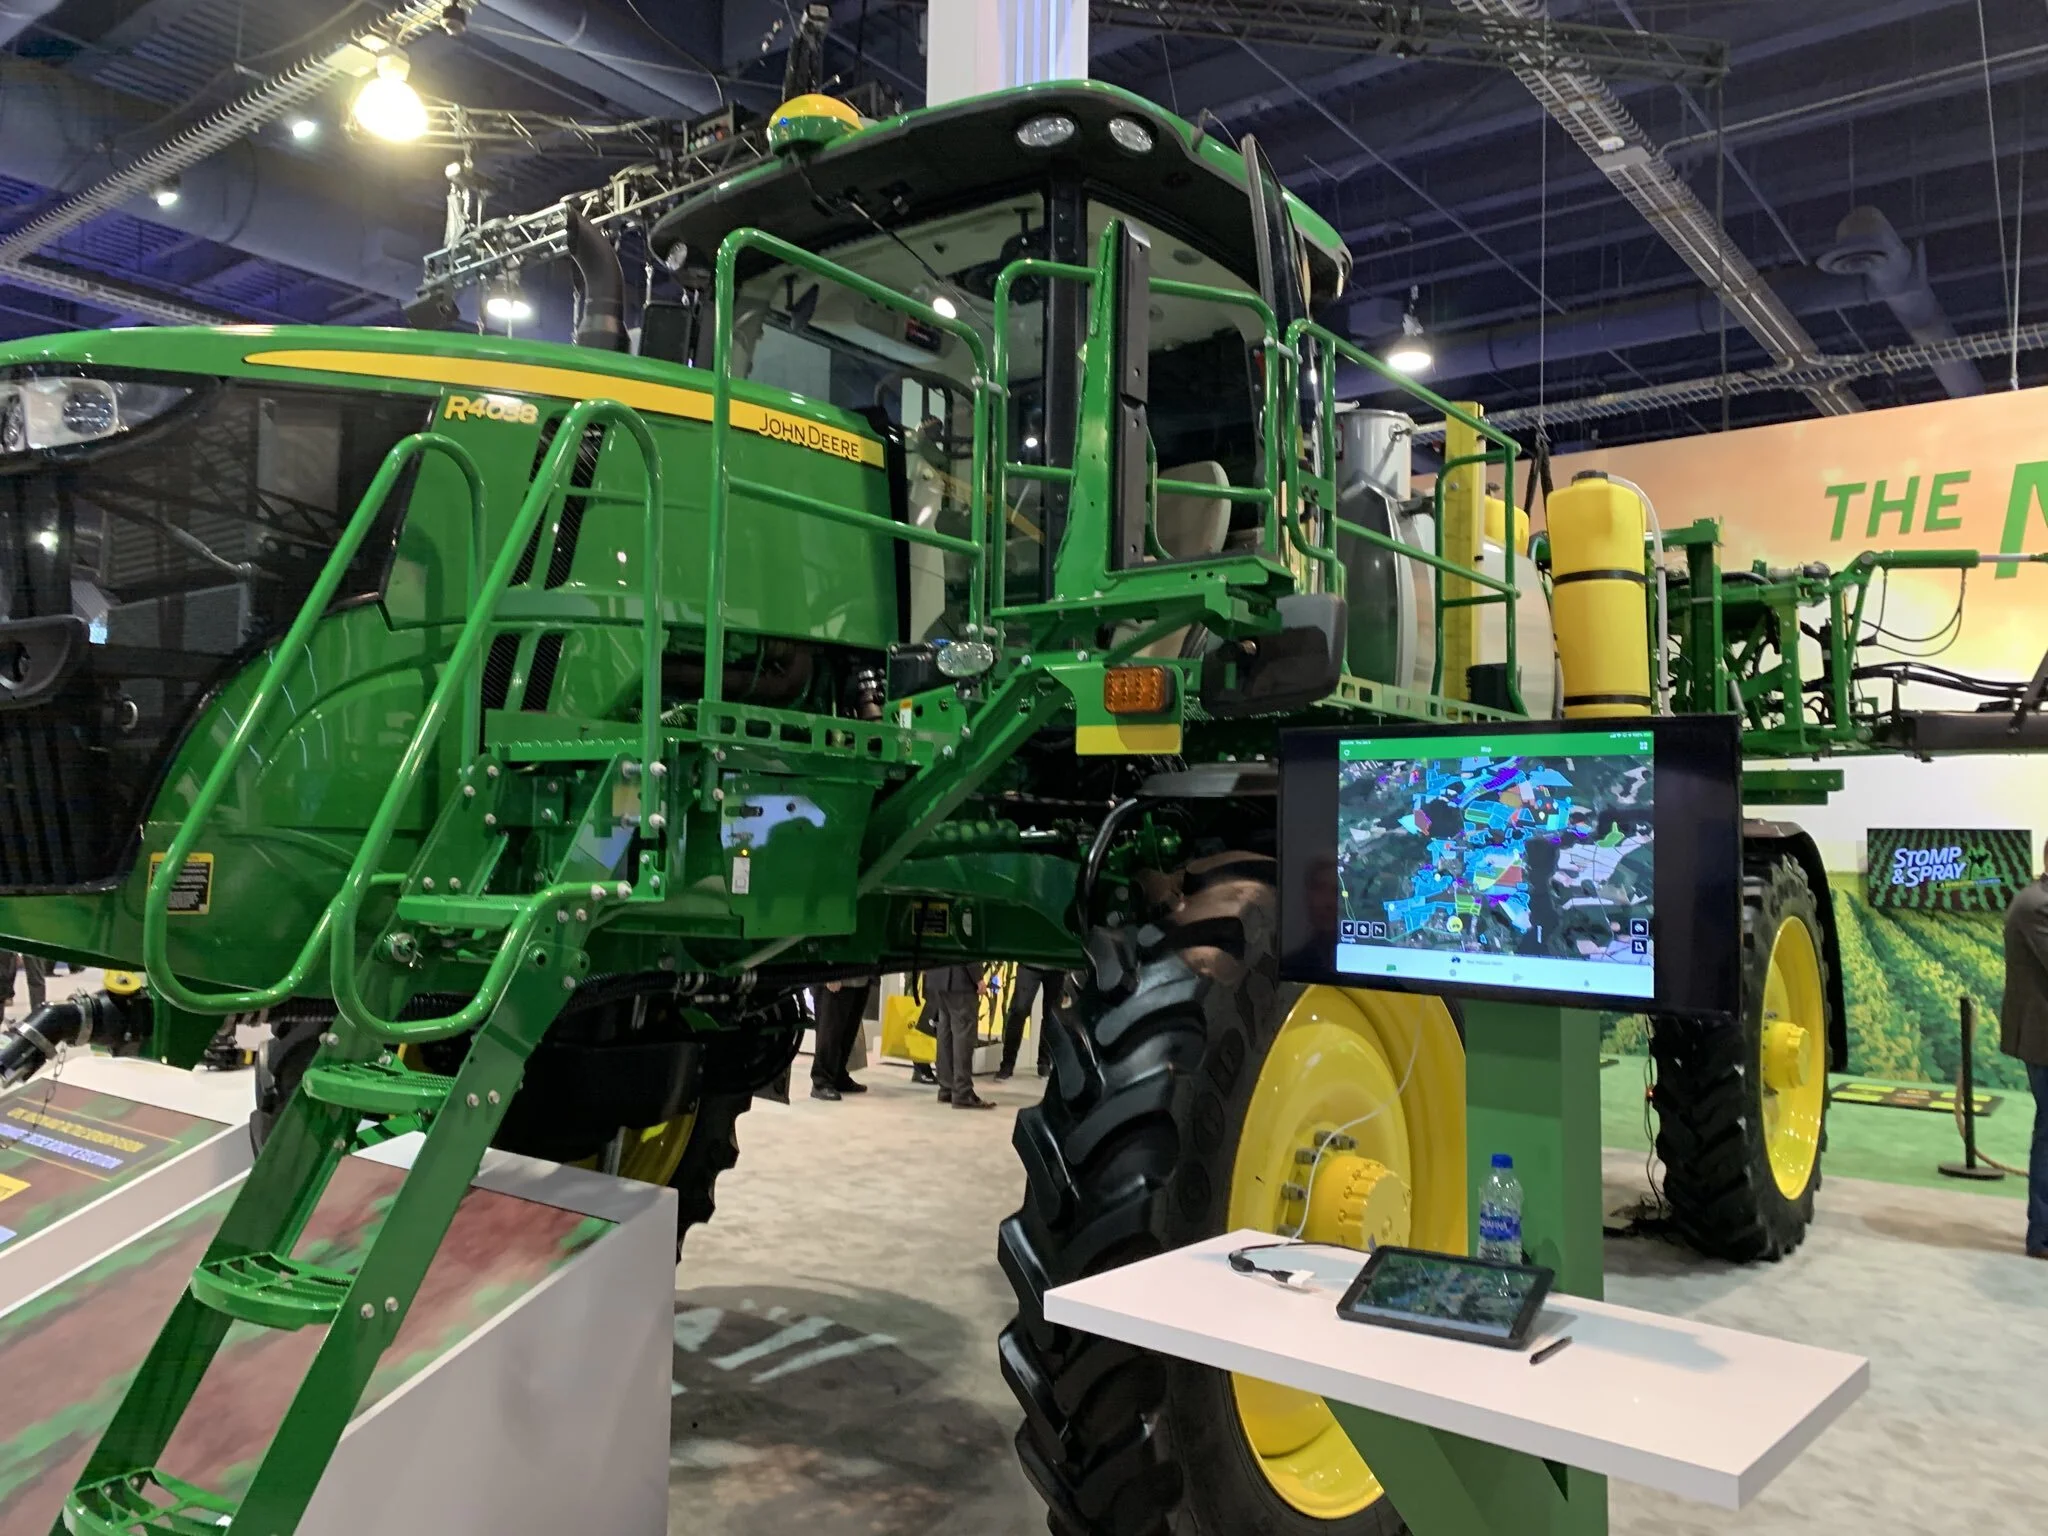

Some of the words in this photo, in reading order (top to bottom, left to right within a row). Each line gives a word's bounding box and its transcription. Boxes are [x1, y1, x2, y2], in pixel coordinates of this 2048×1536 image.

[444, 395, 538, 424] R4038
[1824, 470, 1971, 542] THE
[1893, 847, 1962, 868] STOMP
